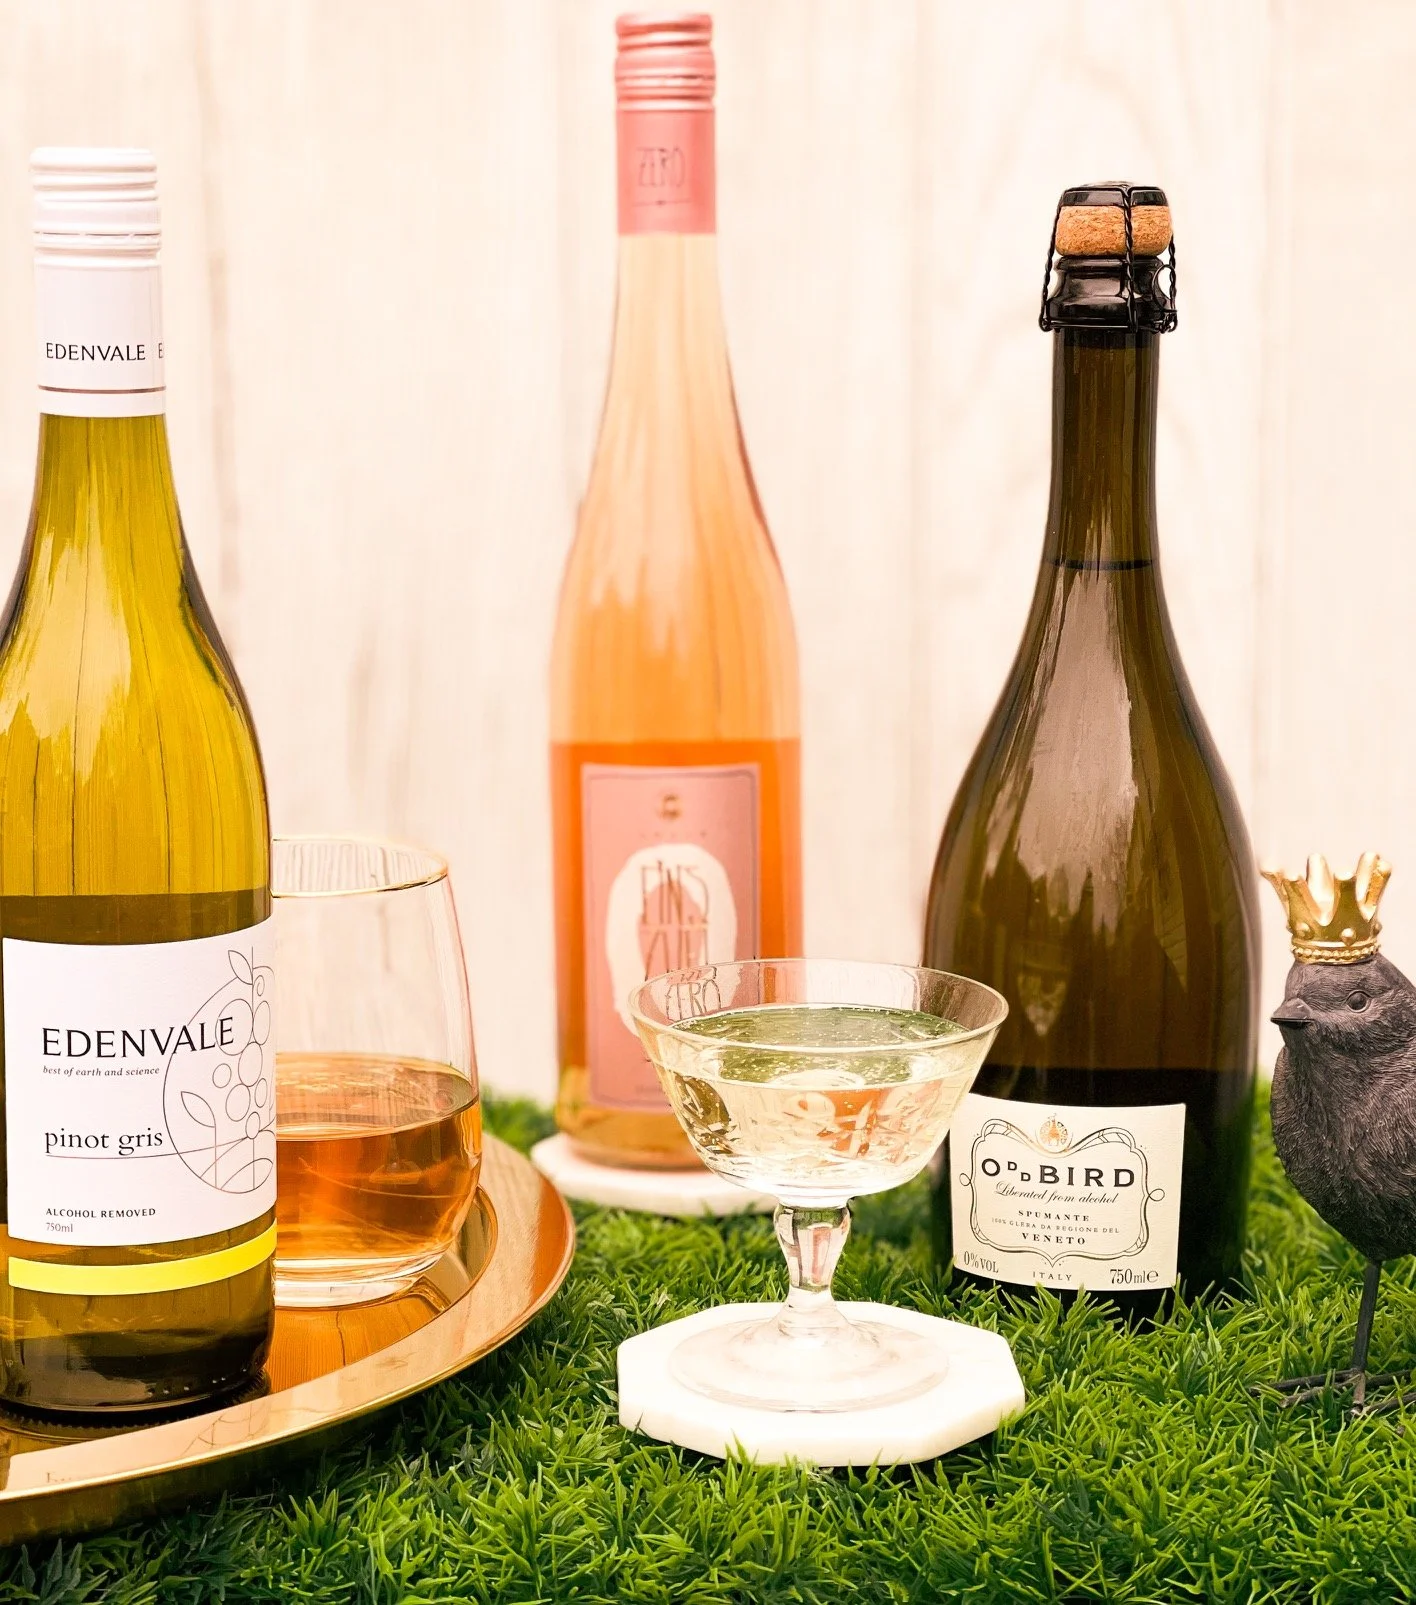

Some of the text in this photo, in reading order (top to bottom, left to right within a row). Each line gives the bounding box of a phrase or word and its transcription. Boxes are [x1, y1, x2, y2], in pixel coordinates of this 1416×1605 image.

[46, 342, 146, 361] EDENVALE
[42, 1016, 235, 1058] EDENVALE
[42, 1065, 160, 1077] best of earth and science
[45, 1128, 164, 1157] pinot gris
[994, 1181, 1119, 1205] Liberated from alcohol
[46, 1207, 156, 1219] ALCOHOL REMOVED
[1018, 1210, 1090, 1222] SPUMANTE
[46, 1222, 74, 1233] 750ml
[1009, 1220, 1036, 1229] GLERA
[1056, 1224, 1099, 1233] REGIONE
[1022, 1232, 1086, 1245] VENETO
[1032, 1271, 1073, 1282] ITALY
